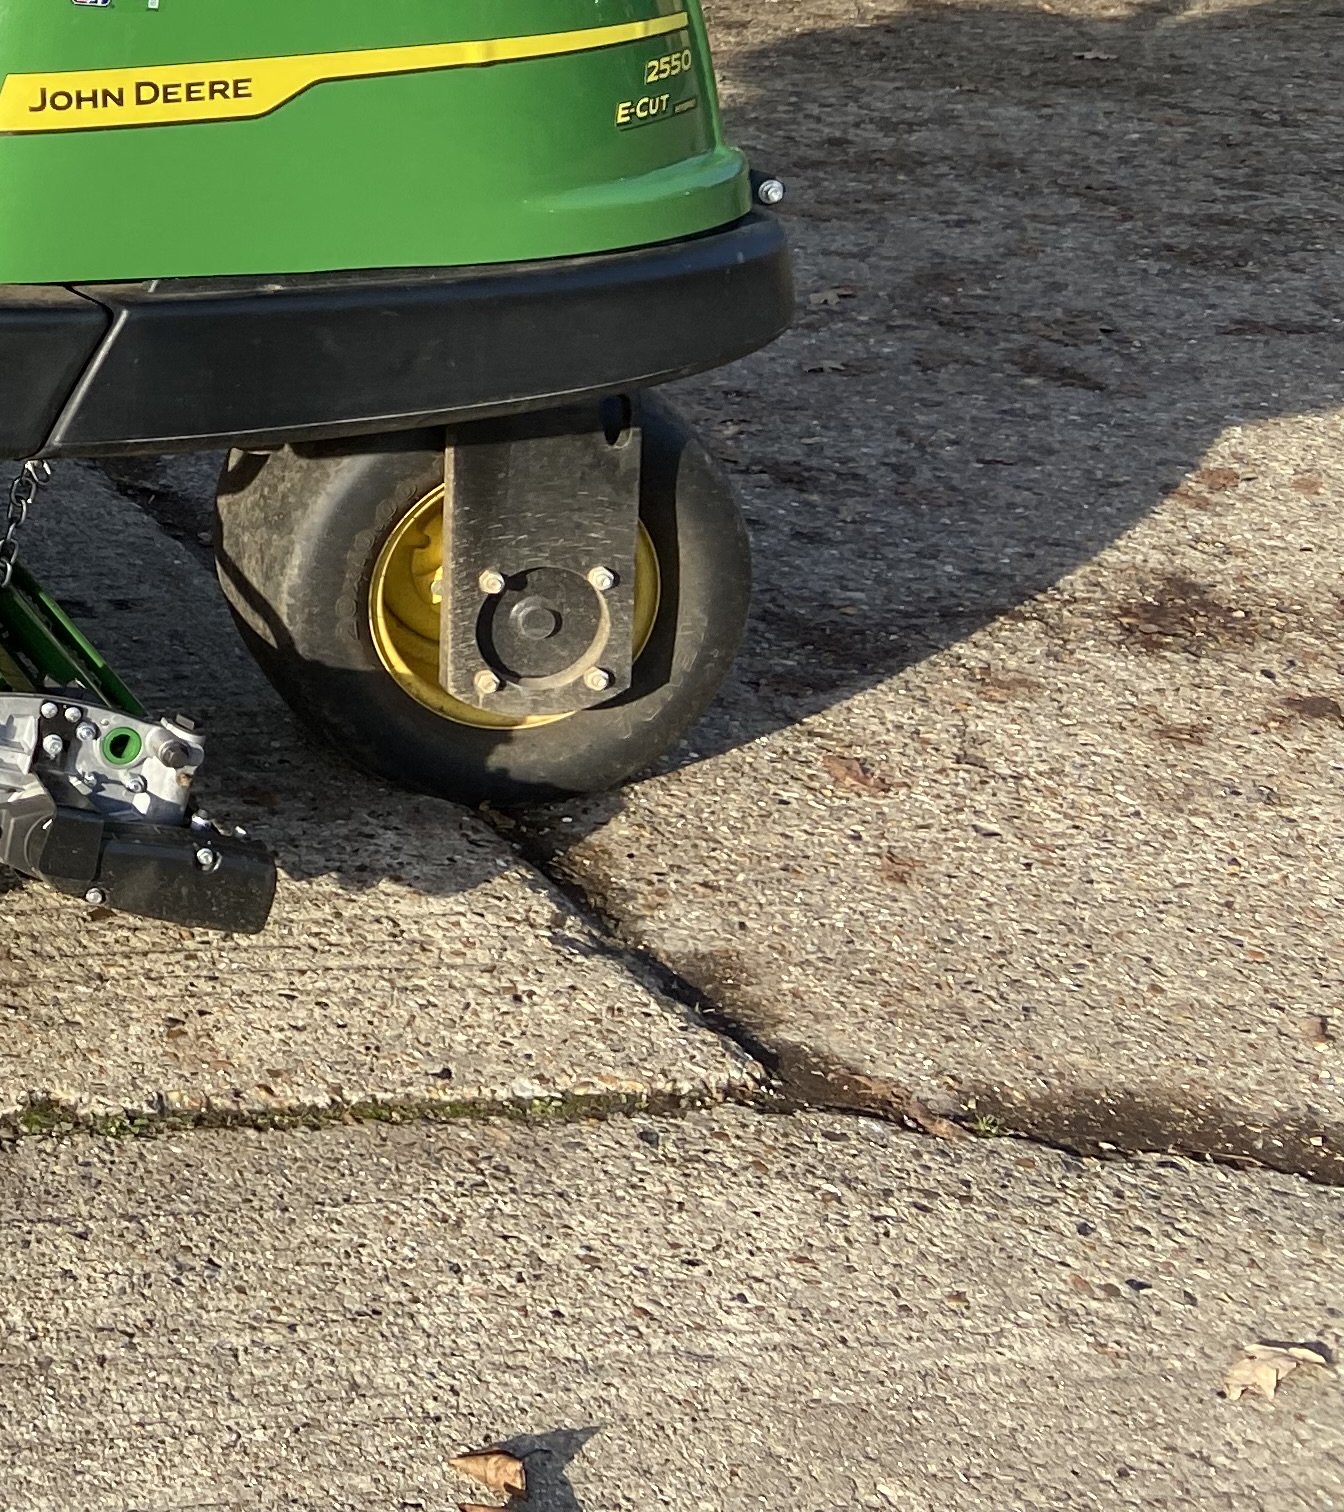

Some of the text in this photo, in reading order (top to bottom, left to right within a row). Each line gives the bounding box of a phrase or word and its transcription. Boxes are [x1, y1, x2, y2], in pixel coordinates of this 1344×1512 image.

[646, 49, 692, 83] 2550
[28, 77, 253, 113] JOHN DEERE
[616, 93, 670, 124] E-CUT
